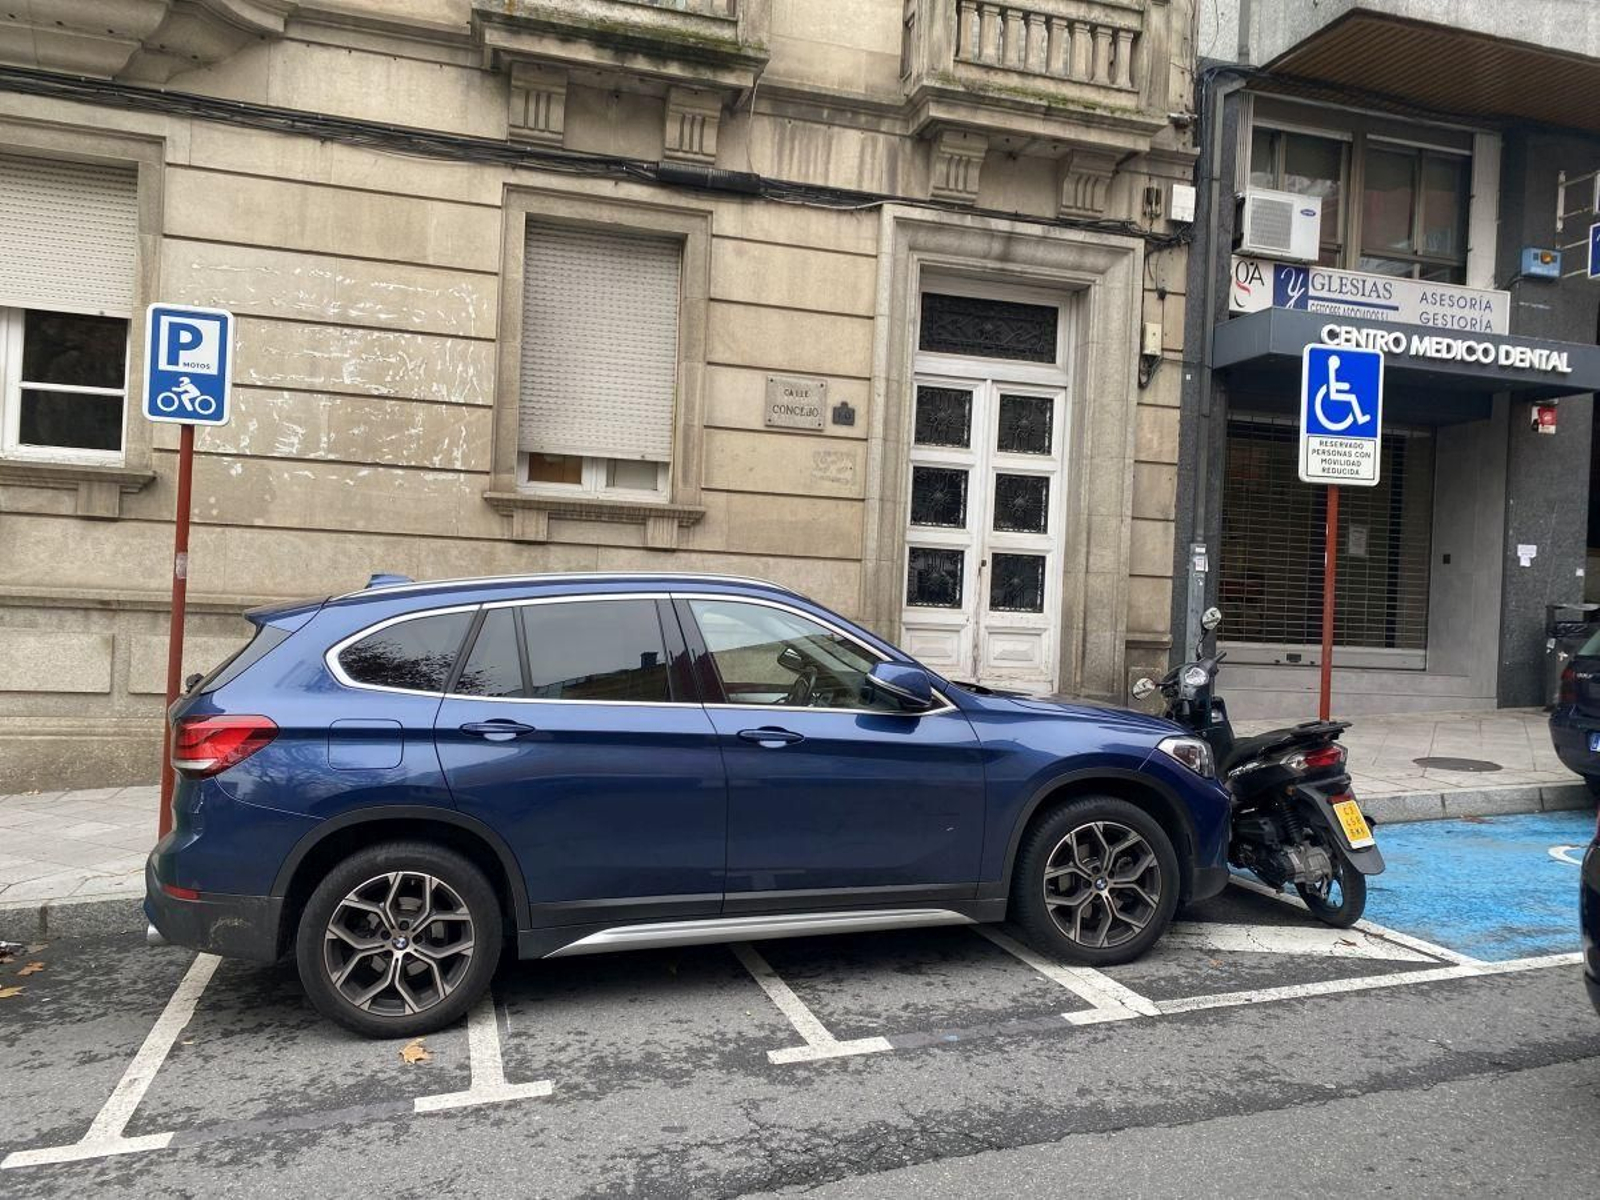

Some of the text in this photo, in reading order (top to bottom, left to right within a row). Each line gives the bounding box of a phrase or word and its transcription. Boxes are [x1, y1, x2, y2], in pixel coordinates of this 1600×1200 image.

[1419, 291, 1493, 313] ASESORÍA
[1419, 311, 1493, 332] GESTORÍA
[166, 321, 203, 366] P
[1320, 323, 1572, 373] CENTRO MEDICO DENTAL
[182, 361, 210, 369] MOTOS
[783, 388, 809, 398] CALLE
[771, 403, 819, 418] CONCEJO
[1319, 440, 1364, 449] RESERVADO
[1311, 448, 1353, 458] PERSONAS
[1320, 458, 1362, 467] MOVILIDAD
[1322, 466, 1360, 475] REDUCIDA
